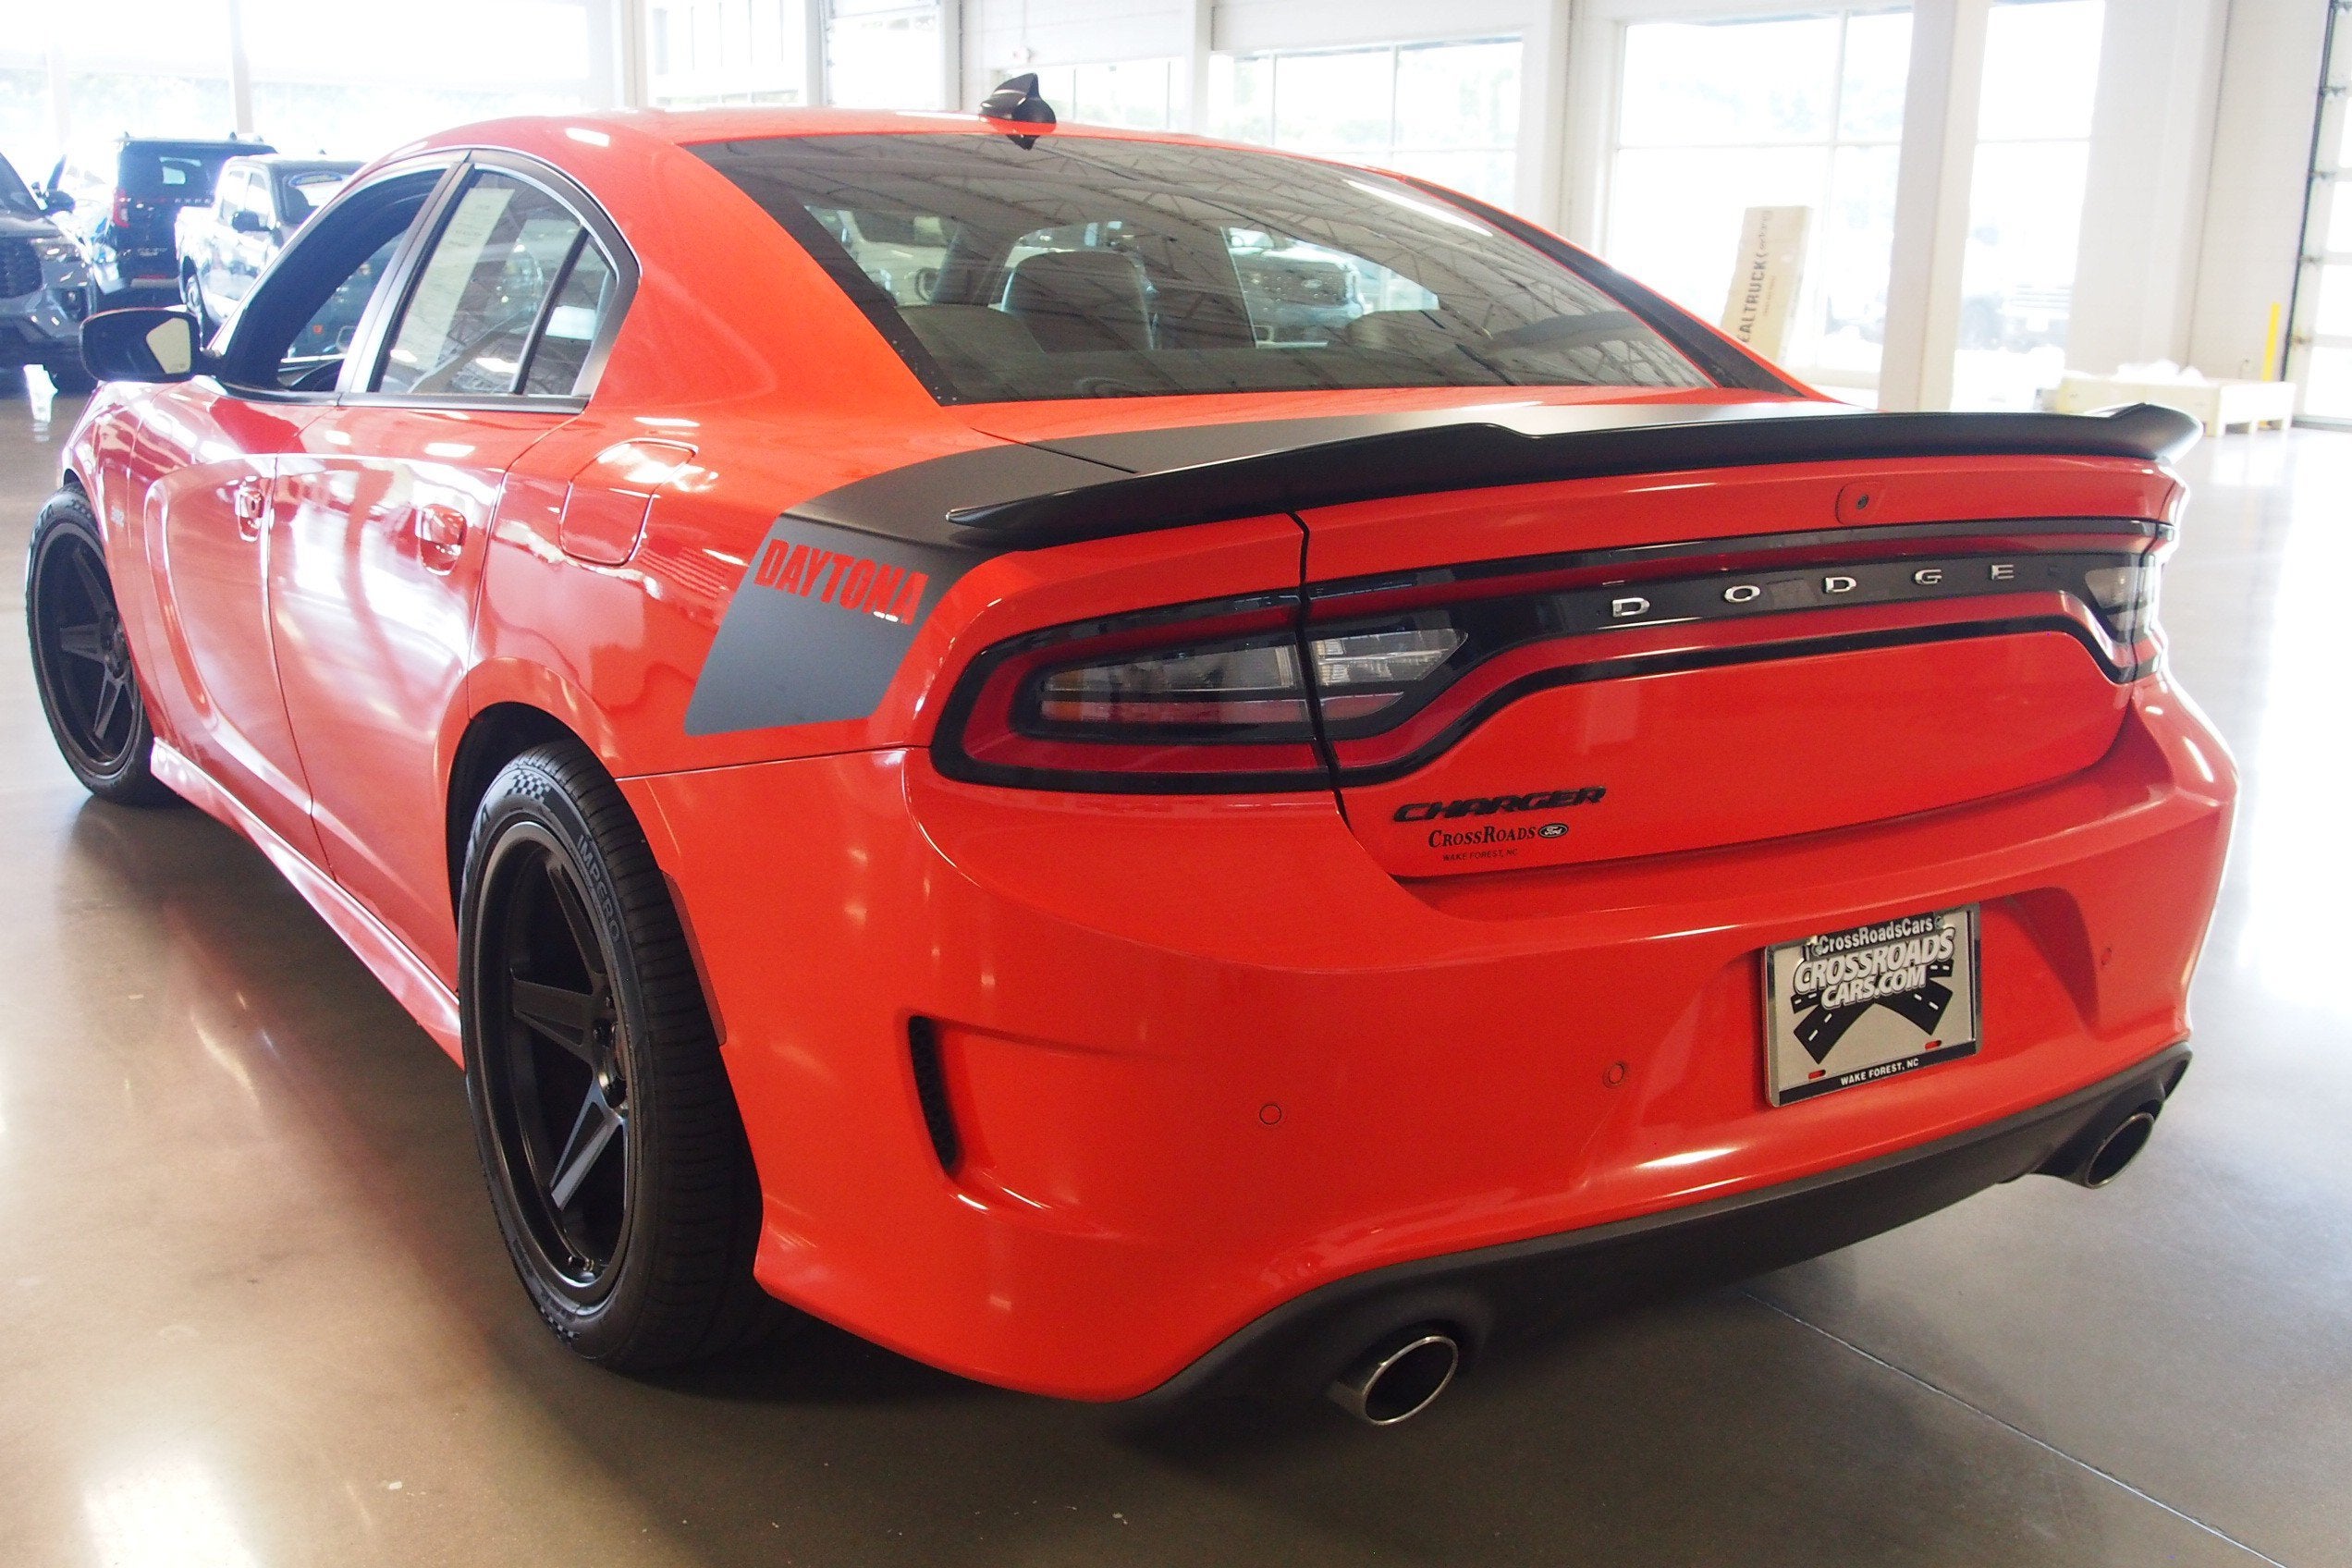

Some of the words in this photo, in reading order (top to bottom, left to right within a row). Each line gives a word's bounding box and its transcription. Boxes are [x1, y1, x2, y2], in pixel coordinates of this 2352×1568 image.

[1735, 261, 1767, 343] EALTRUCK
[753, 538, 929, 625] DAYTONA
[1612, 564, 2014, 618] DODGE
[1392, 786, 1607, 822] CHARGER
[1442, 851, 1468, 862] WAKE
[1506, 848, 1518, 856] NC
[1817, 915, 1934, 955] CrossRoadsCars
[1793, 926, 1956, 994] CROSSROADS
[1821, 966, 1927, 1010] CARS.COM
[1841, 1070, 1867, 1086] WAKE
[1868, 1063, 1905, 1080] FOREST,
[1906, 1058, 1919, 1068] NC
